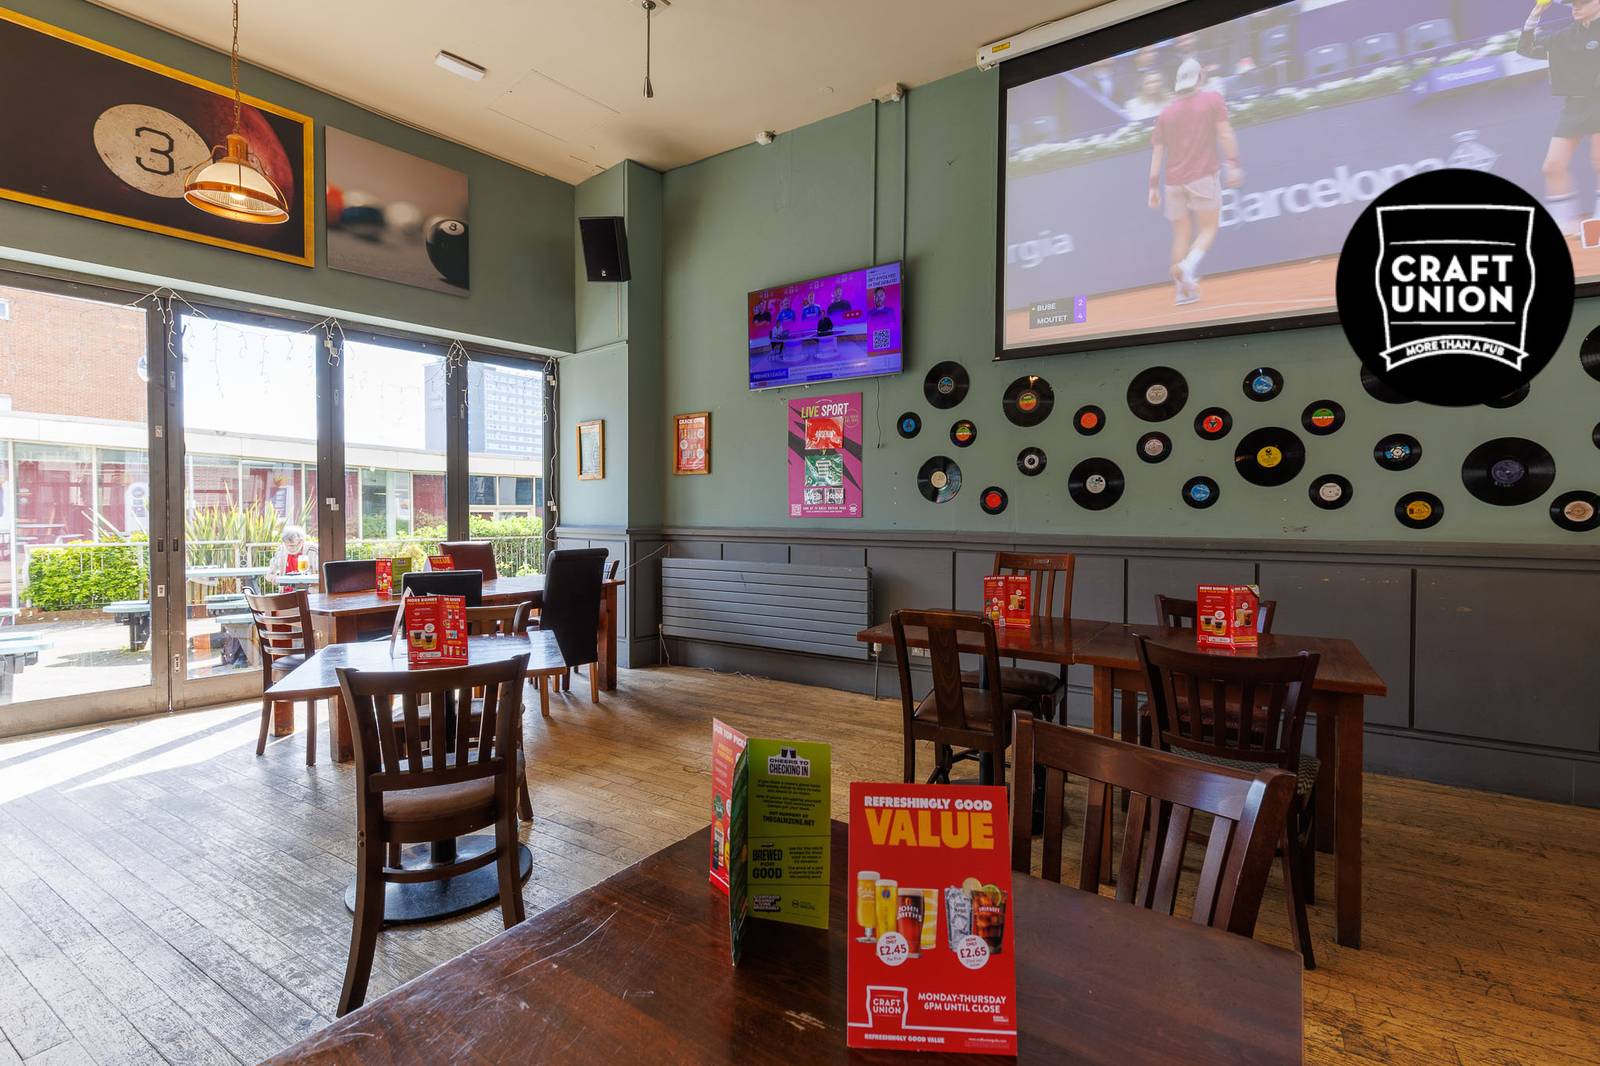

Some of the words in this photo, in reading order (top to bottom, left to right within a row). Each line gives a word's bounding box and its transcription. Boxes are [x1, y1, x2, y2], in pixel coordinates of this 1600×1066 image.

[135, 126, 175, 176] 3
[448, 222, 458, 232] 8
[1037, 302, 1057, 312] BUSE
[1037, 314, 1068, 325] MOUTET
[801, 405, 820, 419] LIVE
[821, 402, 849, 417] SPORT
[769, 763, 801, 775] CHECKING
[801, 765, 809, 776] IN
[864, 795, 951, 810] REFRESHINGLY
[954, 799, 993, 811] GOOD
[864, 807, 994, 850] VALUE
[752, 849, 783, 862] BREWED
[752, 867, 783, 879] GOOD
[880, 944, 907, 955] £2.45
[960, 946, 987, 958] £2.65
[873, 998, 901, 1007] CRAFT
[918, 992, 1007, 1004] MONDAY-THURSDAY
[872, 1005, 901, 1014] UNION
[924, 1003, 942, 1011] 6PM
[944, 1004, 970, 1012] UNTIL
[972, 1005, 1001, 1013] CLOSE
[864, 1033, 907, 1042] REFRESHINGLY
[908, 1035, 927, 1043] GOOD
[927, 1036, 945, 1044] VALUE
